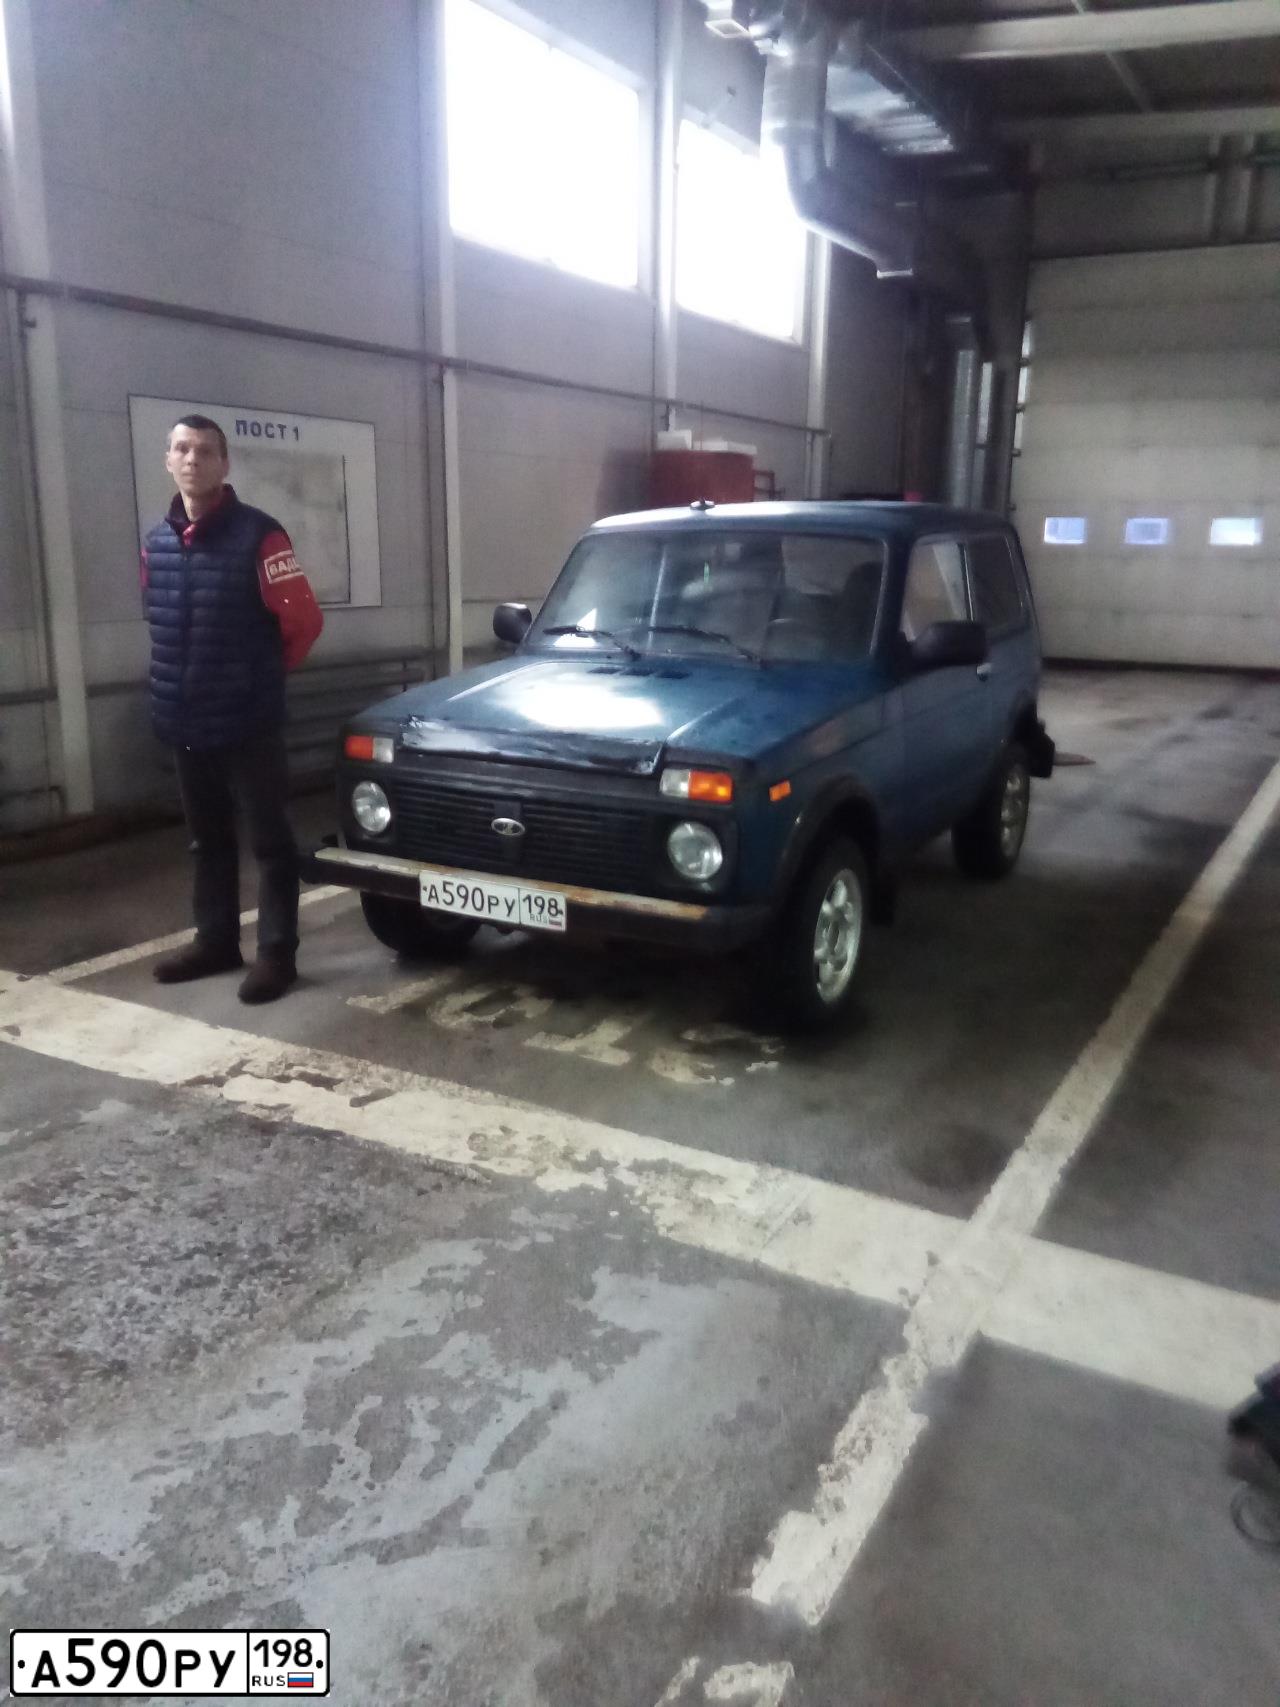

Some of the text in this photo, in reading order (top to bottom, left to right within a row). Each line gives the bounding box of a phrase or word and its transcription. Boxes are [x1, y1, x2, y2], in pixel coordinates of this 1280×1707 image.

[235, 419, 300, 441] ПОСТ 1
[522, 893, 559, 917] 198
